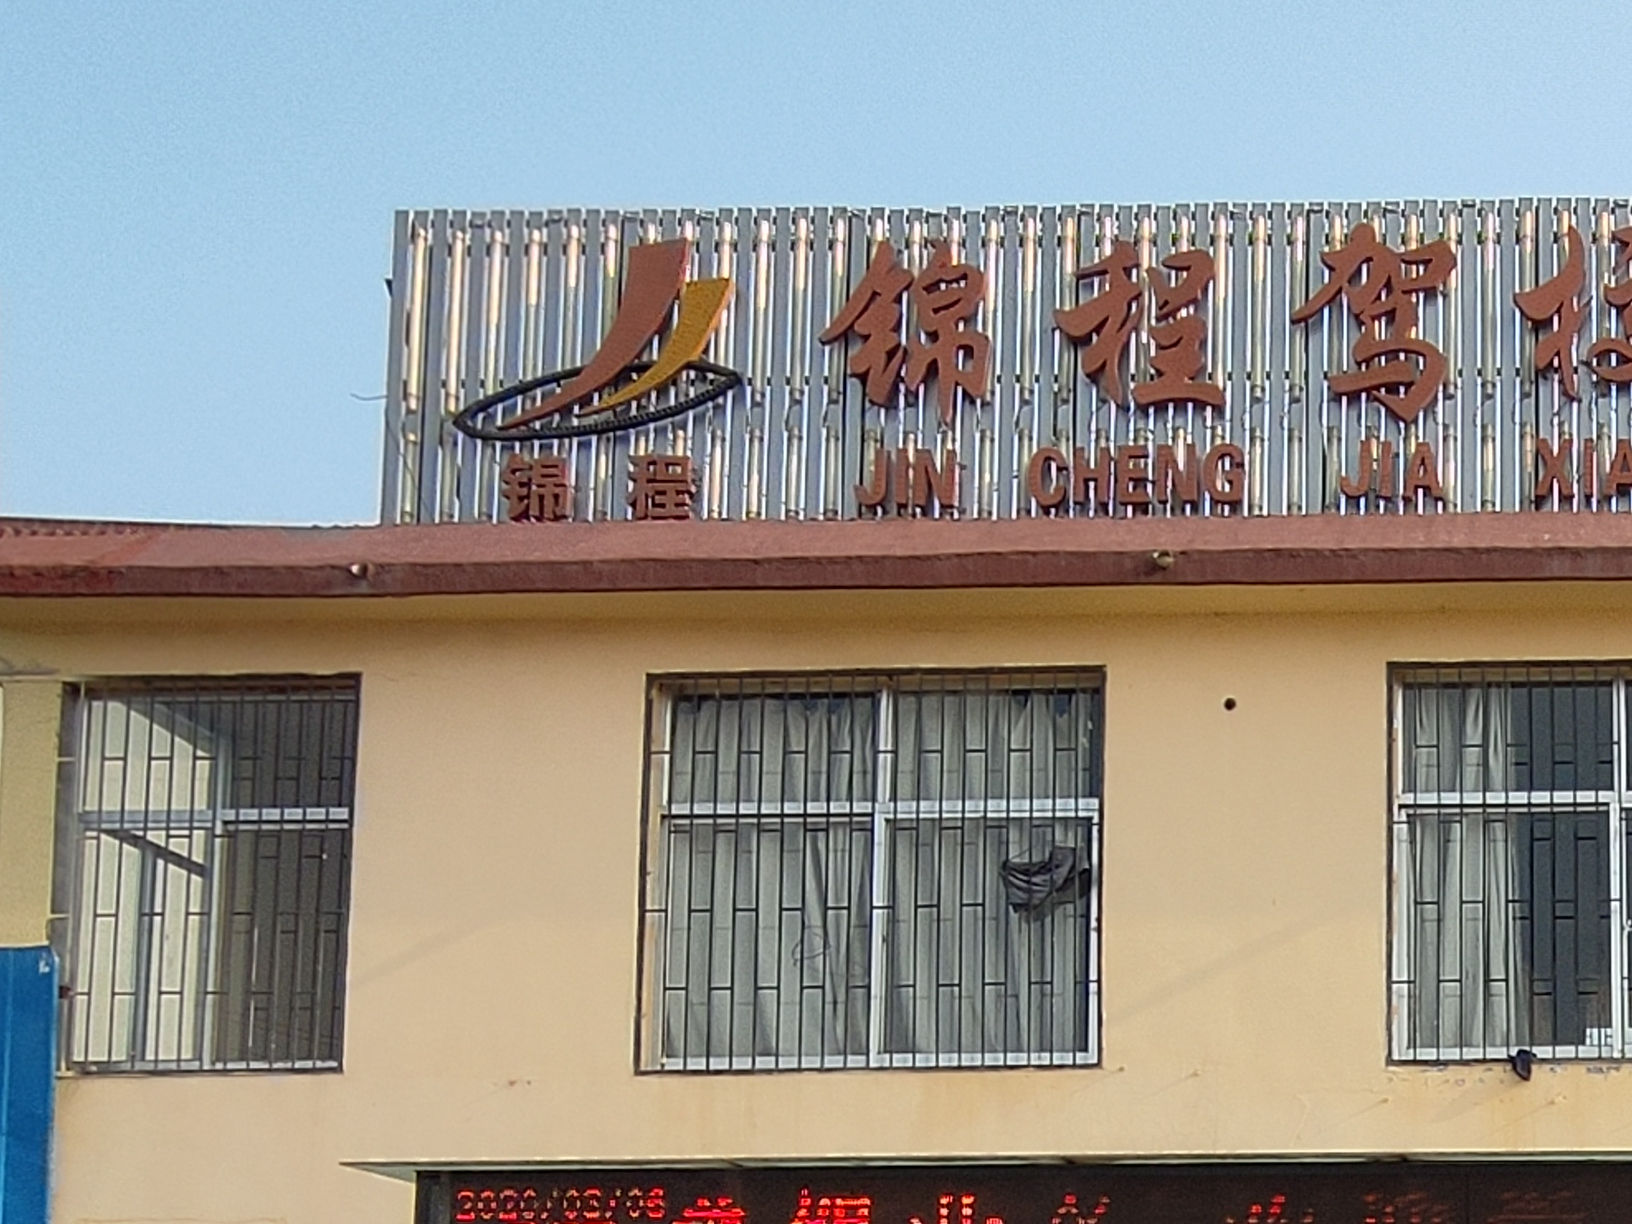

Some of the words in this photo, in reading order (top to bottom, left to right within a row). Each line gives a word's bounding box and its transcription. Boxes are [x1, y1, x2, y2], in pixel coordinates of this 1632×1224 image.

[500, 452, 697, 521] 锦程
[855, 446, 959, 508] JIN
[1027, 442, 1246, 508] CHENG
[1339, 440, 1443, 500] JIA
